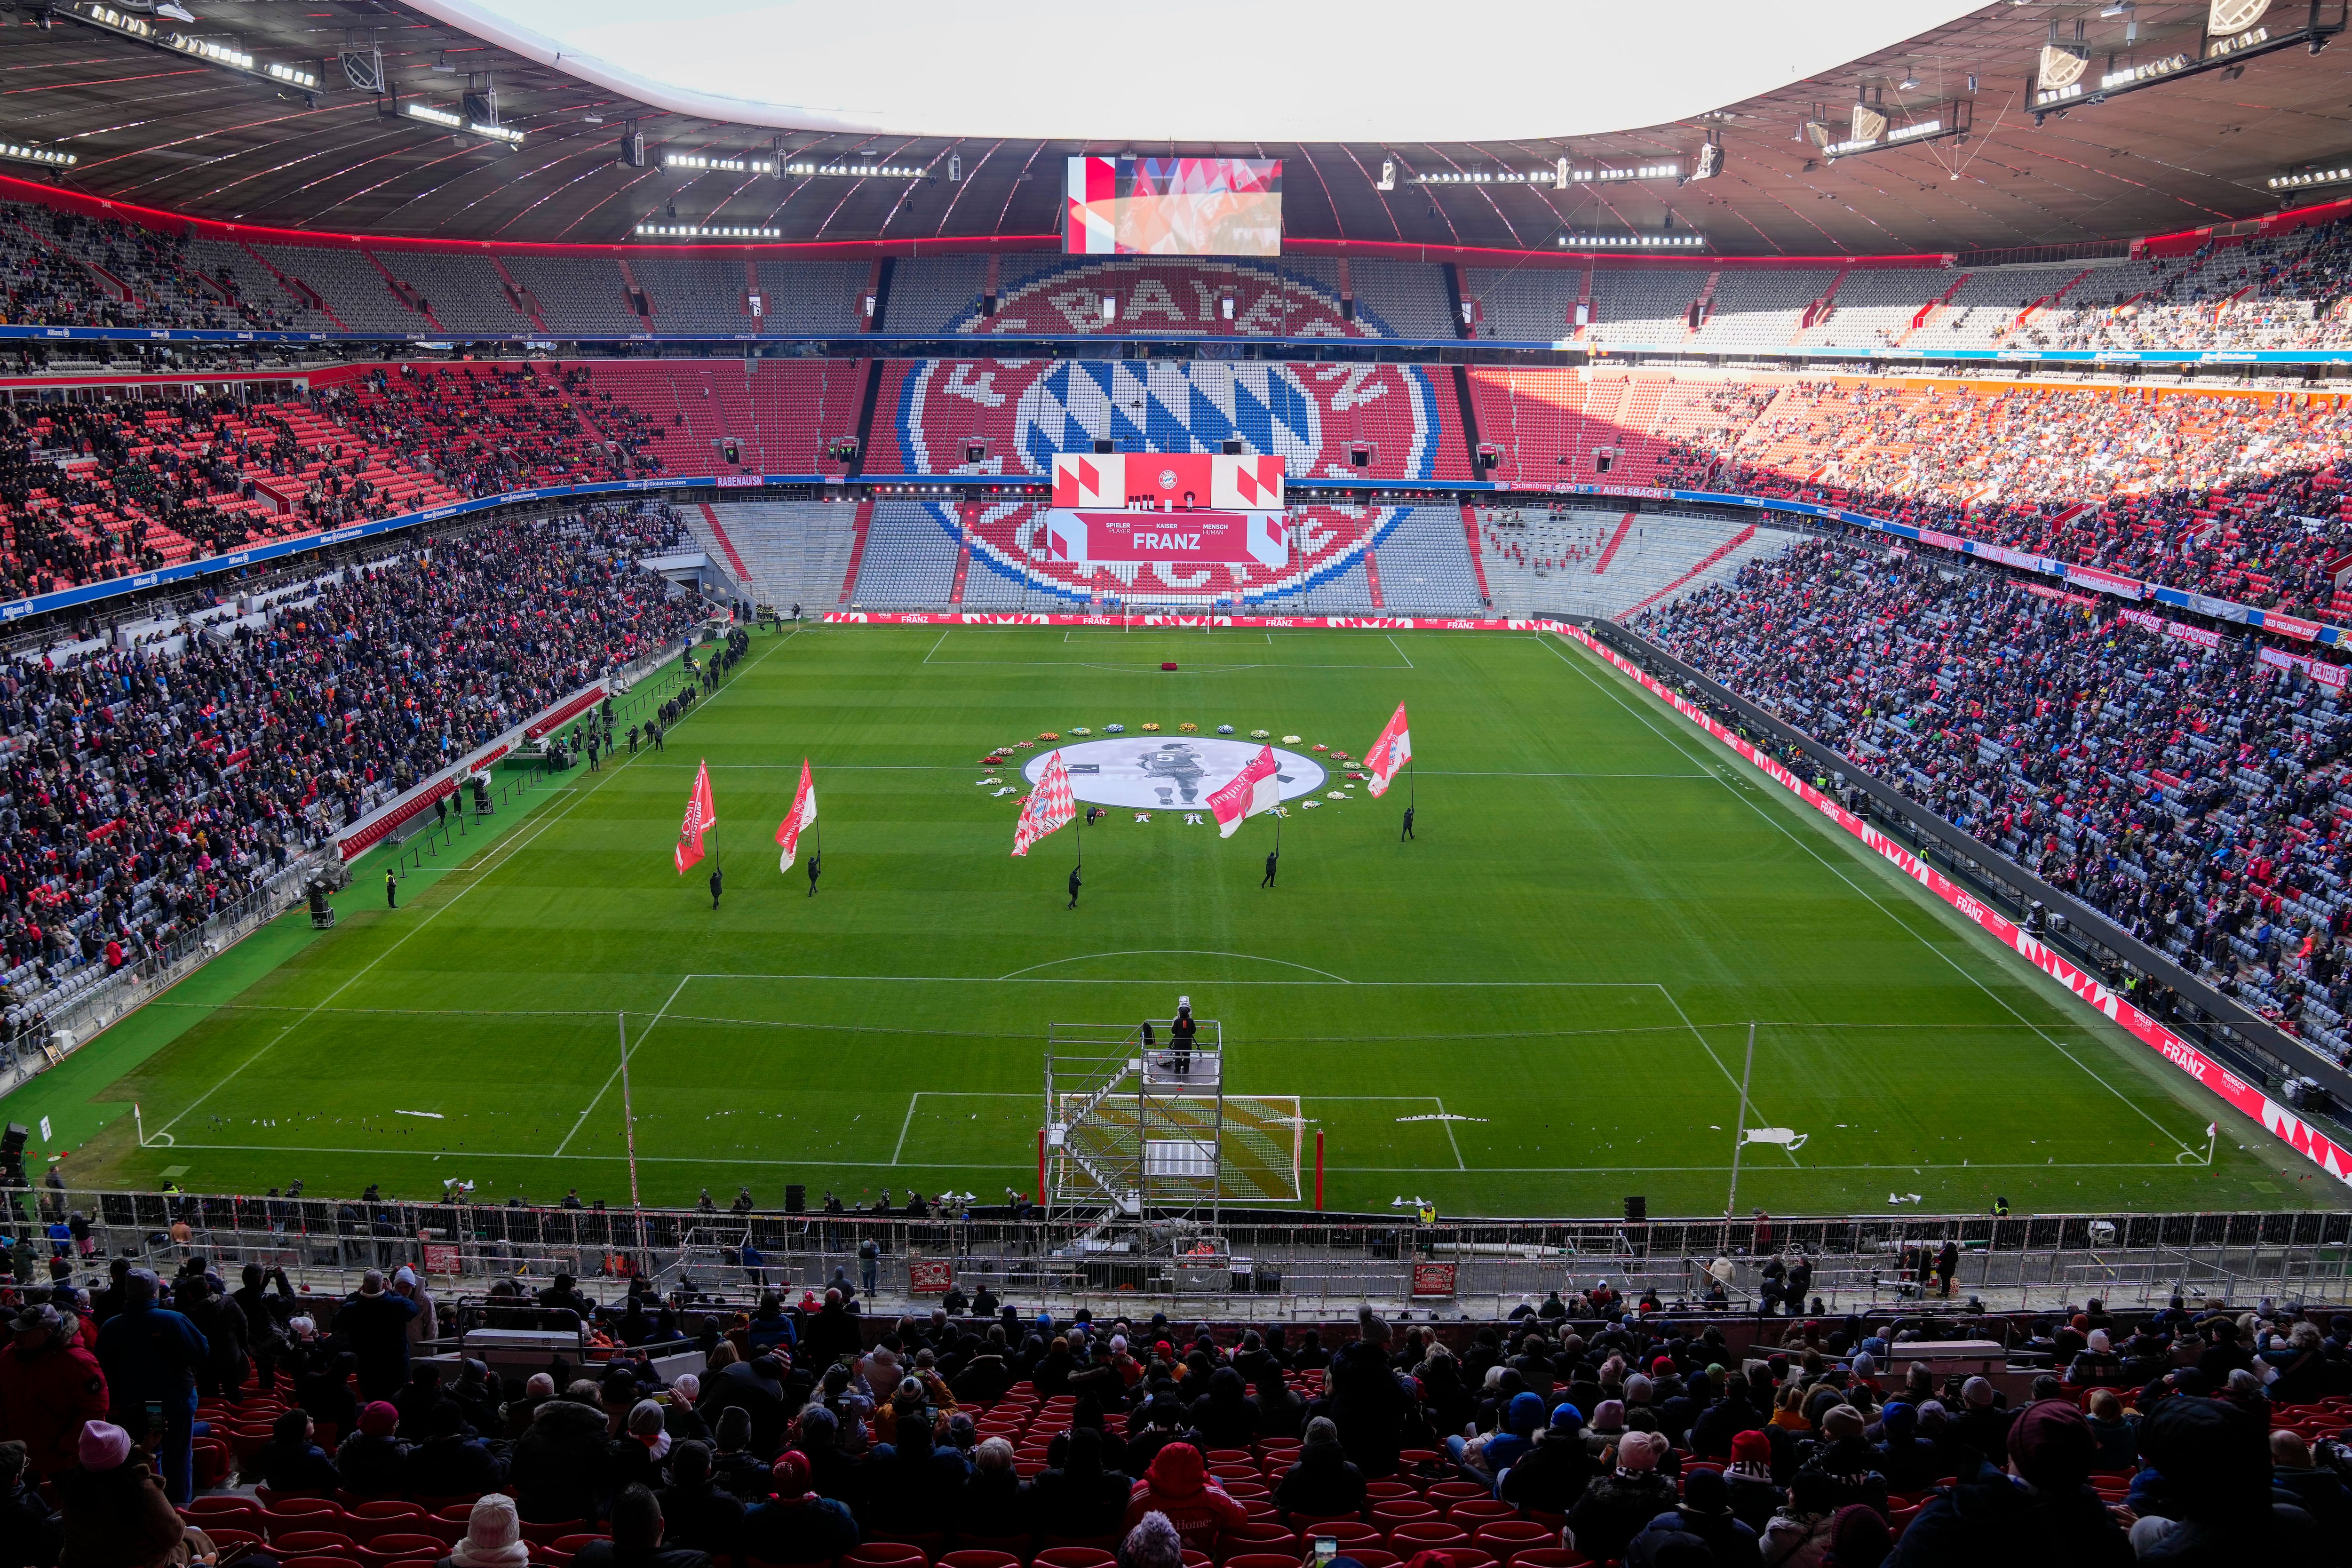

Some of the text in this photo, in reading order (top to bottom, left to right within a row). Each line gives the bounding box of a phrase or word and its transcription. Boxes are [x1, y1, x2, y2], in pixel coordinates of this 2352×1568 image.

[718, 476, 762, 486] RABENAU/SN
[1511, 482, 1552, 491] Schmiding
[1602, 486, 1661, 498] AIGLSBACH
[348, 529, 363, 537] Investors
[1133, 533, 1200, 550] FRANZ
[229, 556, 243, 565] Allianz
[1988, 547, 2002, 561] BULLS
[2002, 550, 2033, 568] TAUBENBACH
[134, 577, 151, 587] Allianz
[2265, 618, 2276, 627] RED
[2277, 621, 2302, 634] RELIGION
[2169, 622, 2185, 637] RED
[2185, 627, 2218, 647] POWER
[1596, 645, 1605, 656] FRANZ
[2310, 662, 2339, 683] SELTERS
[1652, 683, 1662, 697] FRANZ
[1724, 733, 1738, 750] FRANZ
[1157, 753, 1176, 762] 5
[1820, 800, 1840, 821] FRANZ
[1938, 876, 1950, 888] SPIELER
[1938, 882, 1950, 893] PLAYER
[1965, 894, 1977, 906] KAISER
[1956, 895, 1983, 923] FRANZ
[1992, 919, 2004, 931] HUMAN
[1993, 913, 2007, 928] MENSCH
[2133, 1011, 2152, 1027] SPIELER
[2134, 1018, 2151, 1034] PLAYER
[2177, 1040, 2195, 1057] KAISER
[2163, 1039, 2206, 1081] FRANZ
[2221, 1080, 2240, 1097] HUMAN
[2222, 1072, 2246, 1092] MENSCH
